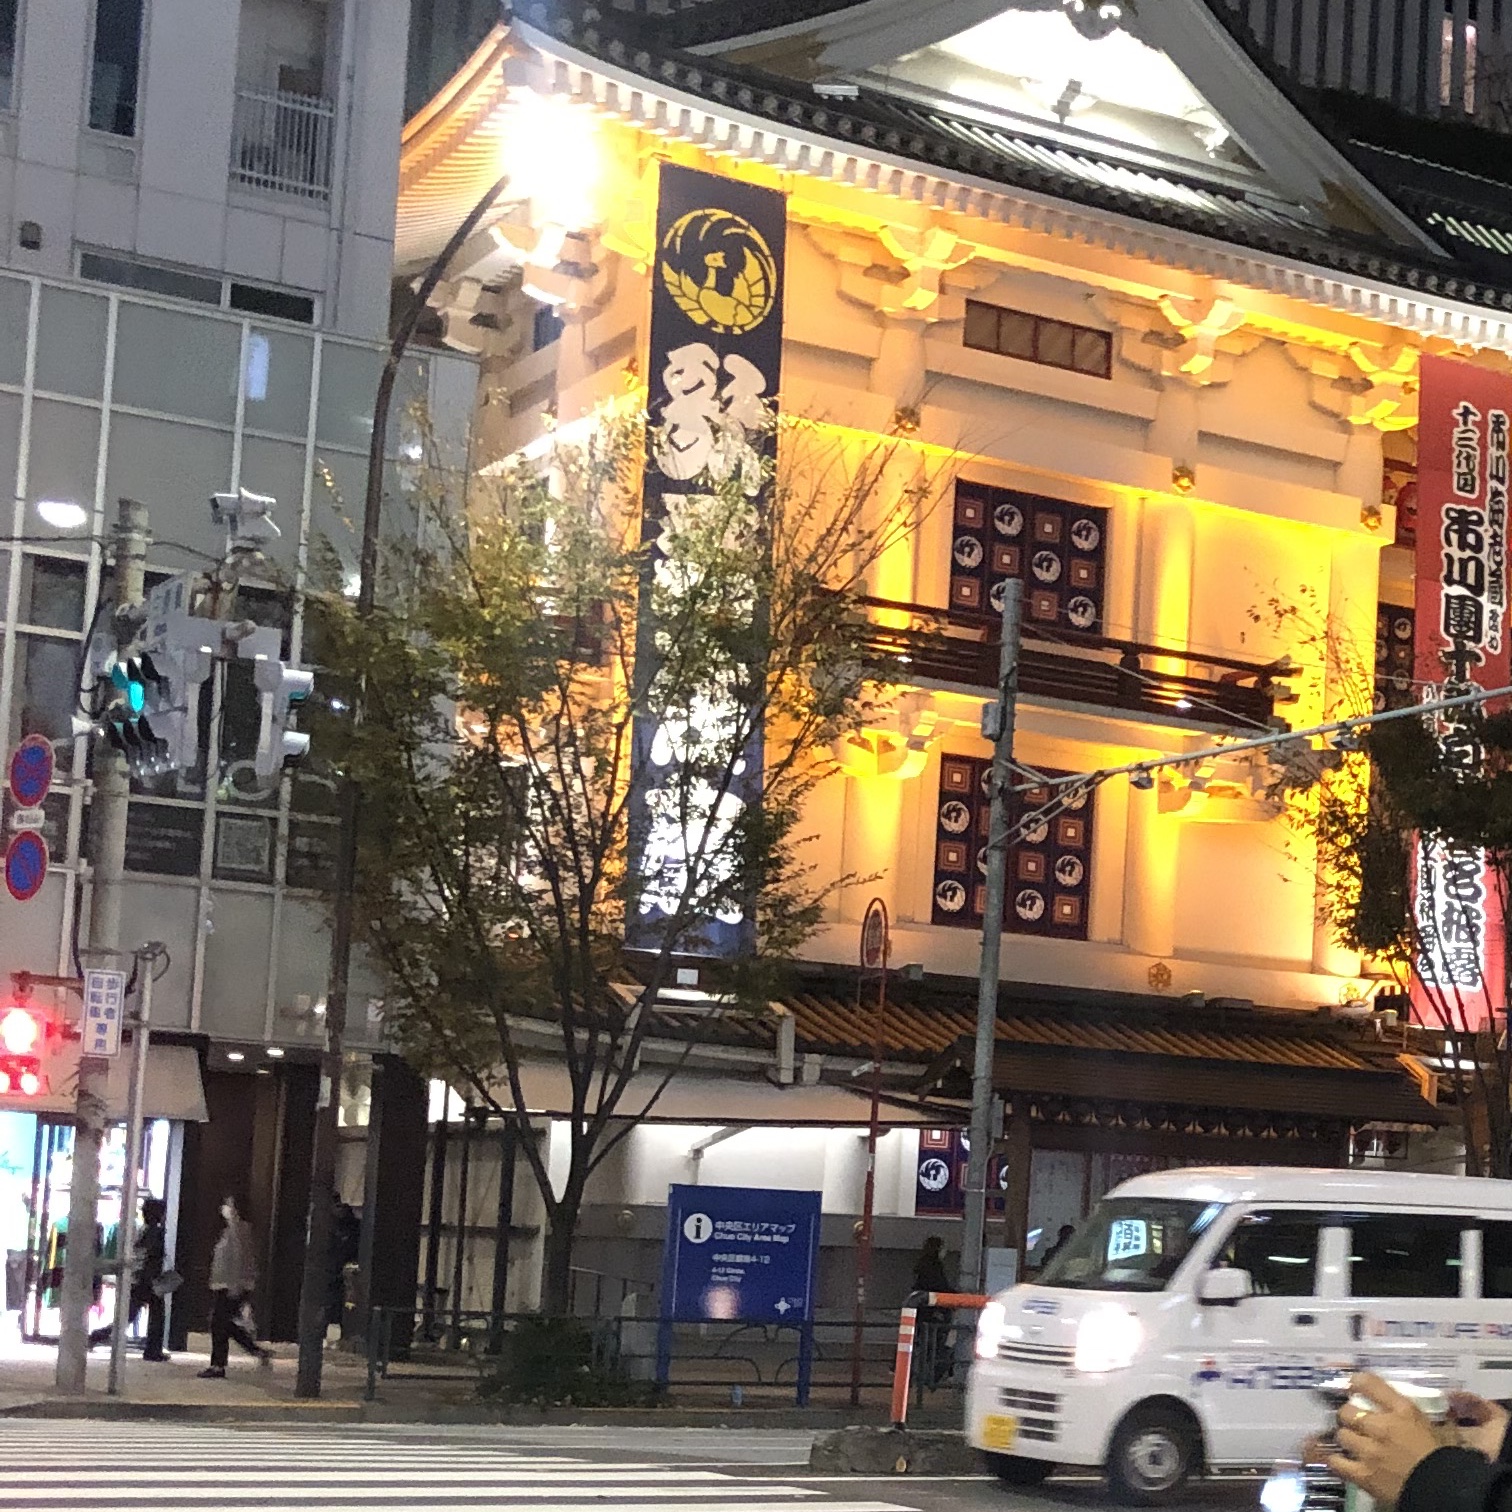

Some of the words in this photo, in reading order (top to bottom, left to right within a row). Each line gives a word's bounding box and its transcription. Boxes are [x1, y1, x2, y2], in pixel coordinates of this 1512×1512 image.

[715, 1221, 796, 1233] 中央区エリアマップ
[737, 1232, 751, 1243] City
